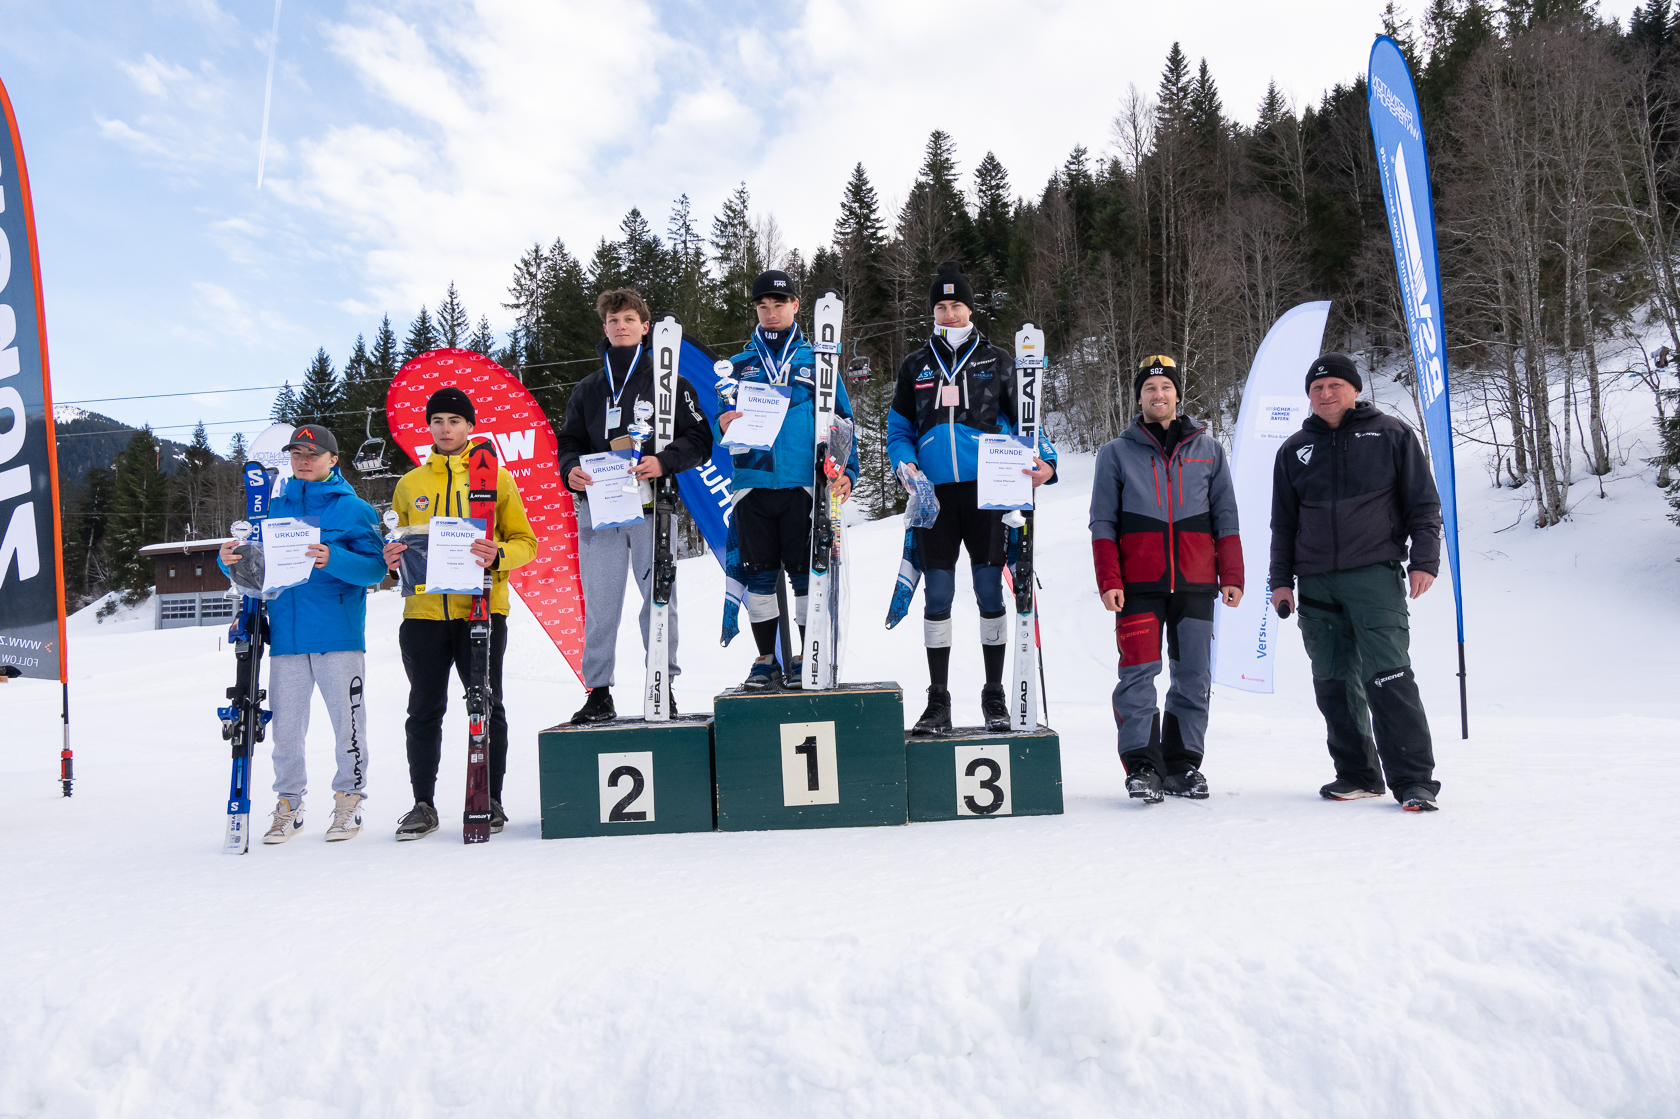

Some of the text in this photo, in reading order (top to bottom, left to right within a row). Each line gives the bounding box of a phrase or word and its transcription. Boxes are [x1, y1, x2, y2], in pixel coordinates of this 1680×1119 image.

[659, 346, 673, 440] HEAD
[748, 396, 780, 406] URKUNDE
[592, 463, 625, 474] URKUNDE
[989, 448, 1023, 456] URKUNDE
[274, 530, 310, 539] URKUNDE
[440, 531, 475, 539] URKUNDE
[1126, 627, 1150, 639] ziener
[811, 640, 820, 686] HEAD
[1380, 671, 1405, 684] ziener
[653, 670, 662, 715] HEAD
[1020, 680, 1028, 726] HEAD
[345, 675, 363, 790] Champion
[795, 735, 820, 792] 1
[963, 757, 1005, 815] 3
[607, 765, 647, 823] 2
